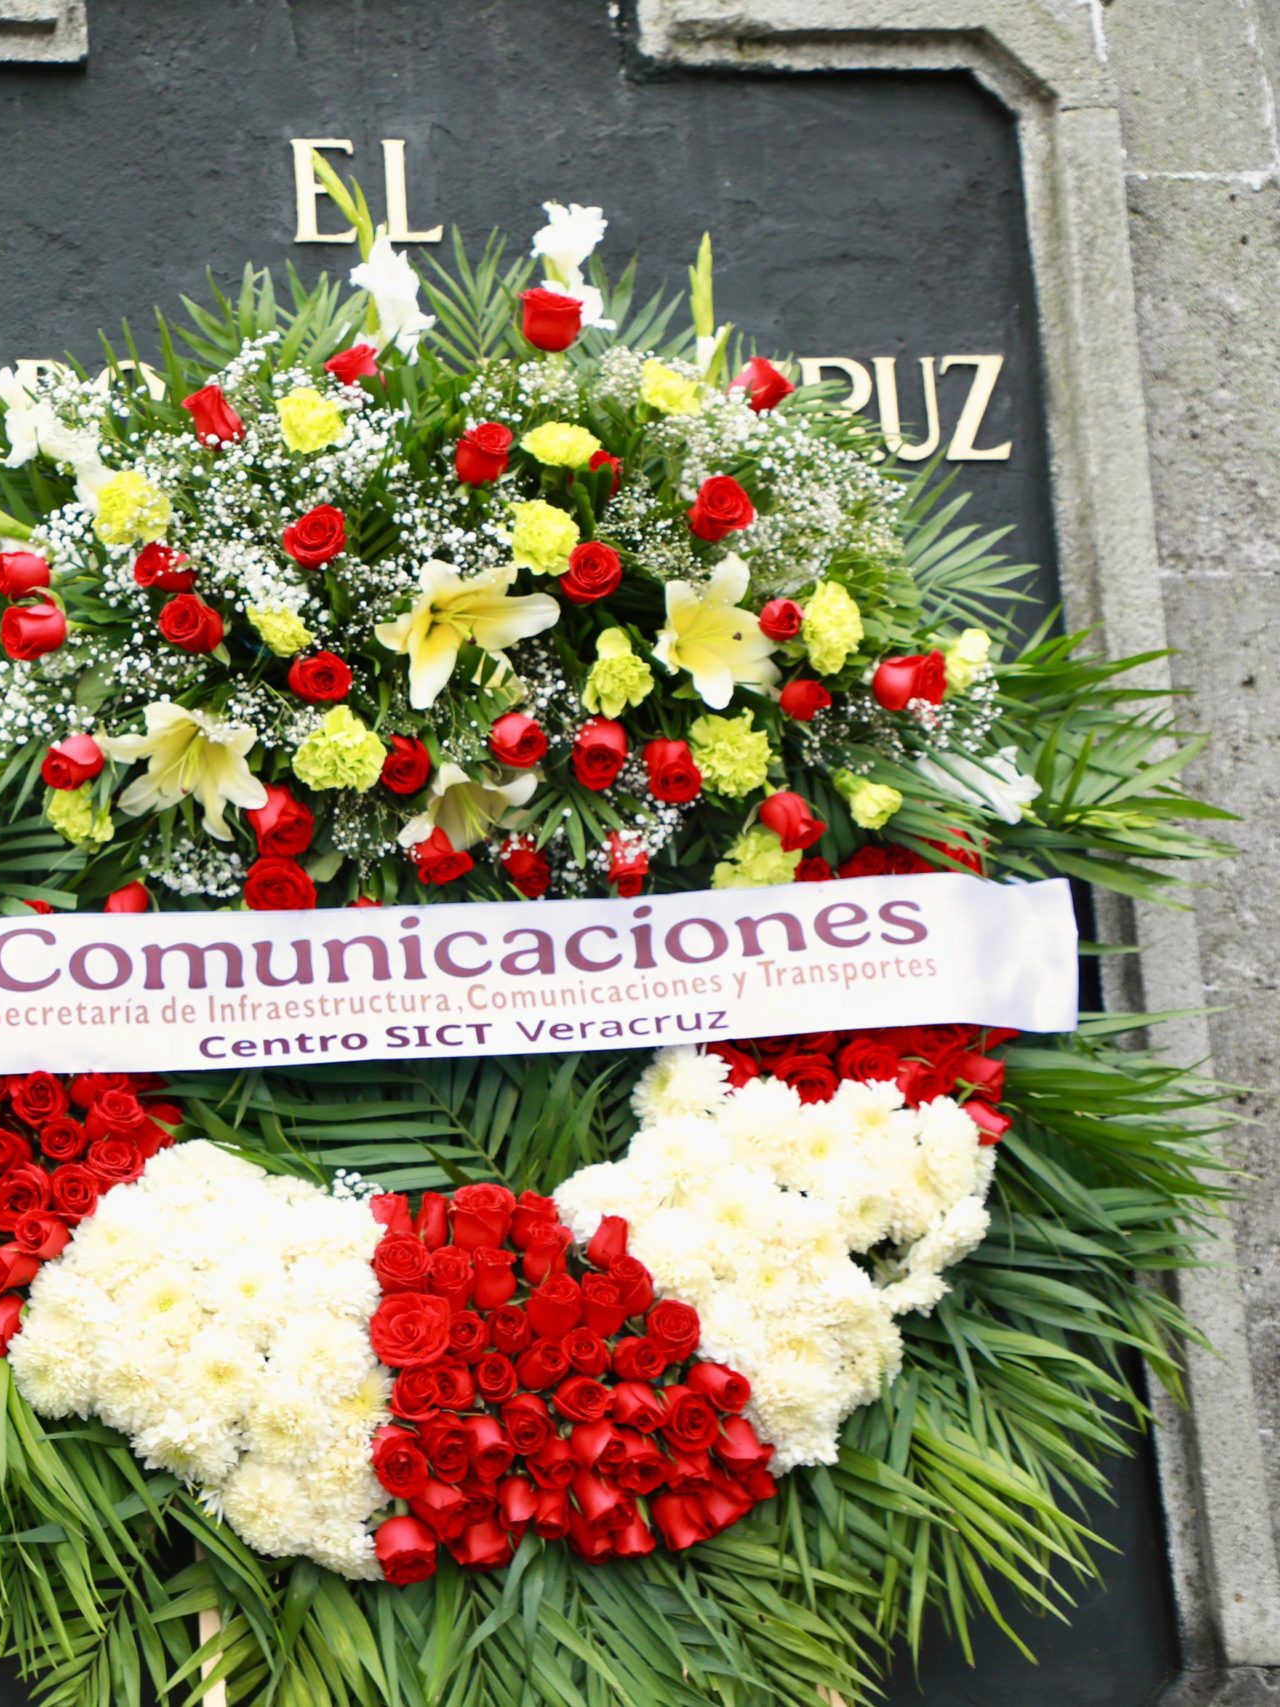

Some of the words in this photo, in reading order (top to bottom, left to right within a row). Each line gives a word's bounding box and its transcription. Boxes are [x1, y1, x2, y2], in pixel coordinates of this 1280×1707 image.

[289, 138, 444, 244] EL
[161, 996, 197, 1025] de
[208, 992, 464, 1023] Infraestructura,
[467, 975, 723, 1010] Comunicaciones
[732, 972, 747, 999] y
[755, 956, 938, 989] Transportes
[198, 1032, 369, 1060] Centro
[384, 1021, 493, 1049] SICT
[515, 1010, 730, 1043] Veracruz
